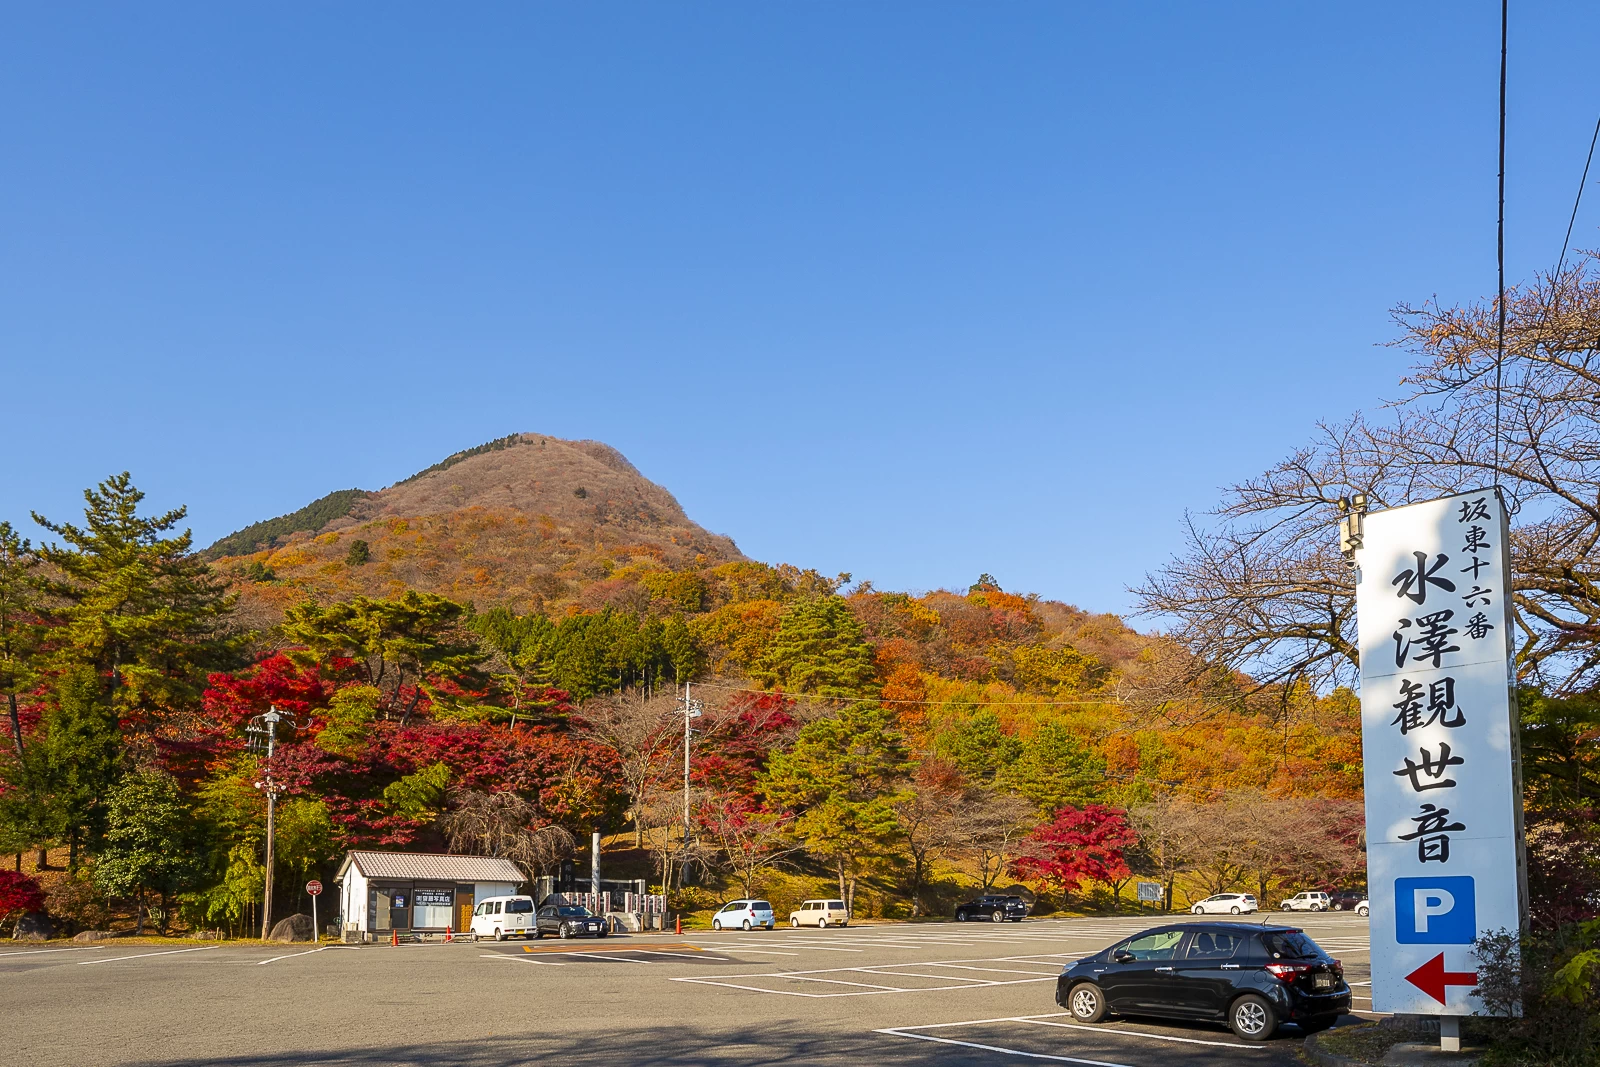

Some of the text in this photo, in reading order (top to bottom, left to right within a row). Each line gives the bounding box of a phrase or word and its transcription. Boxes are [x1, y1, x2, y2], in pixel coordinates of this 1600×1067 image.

[1458, 497, 1494, 640] 坂東十六番
[1391, 551, 1467, 863] 水澤観世音
[1413, 888, 1455, 933] P
